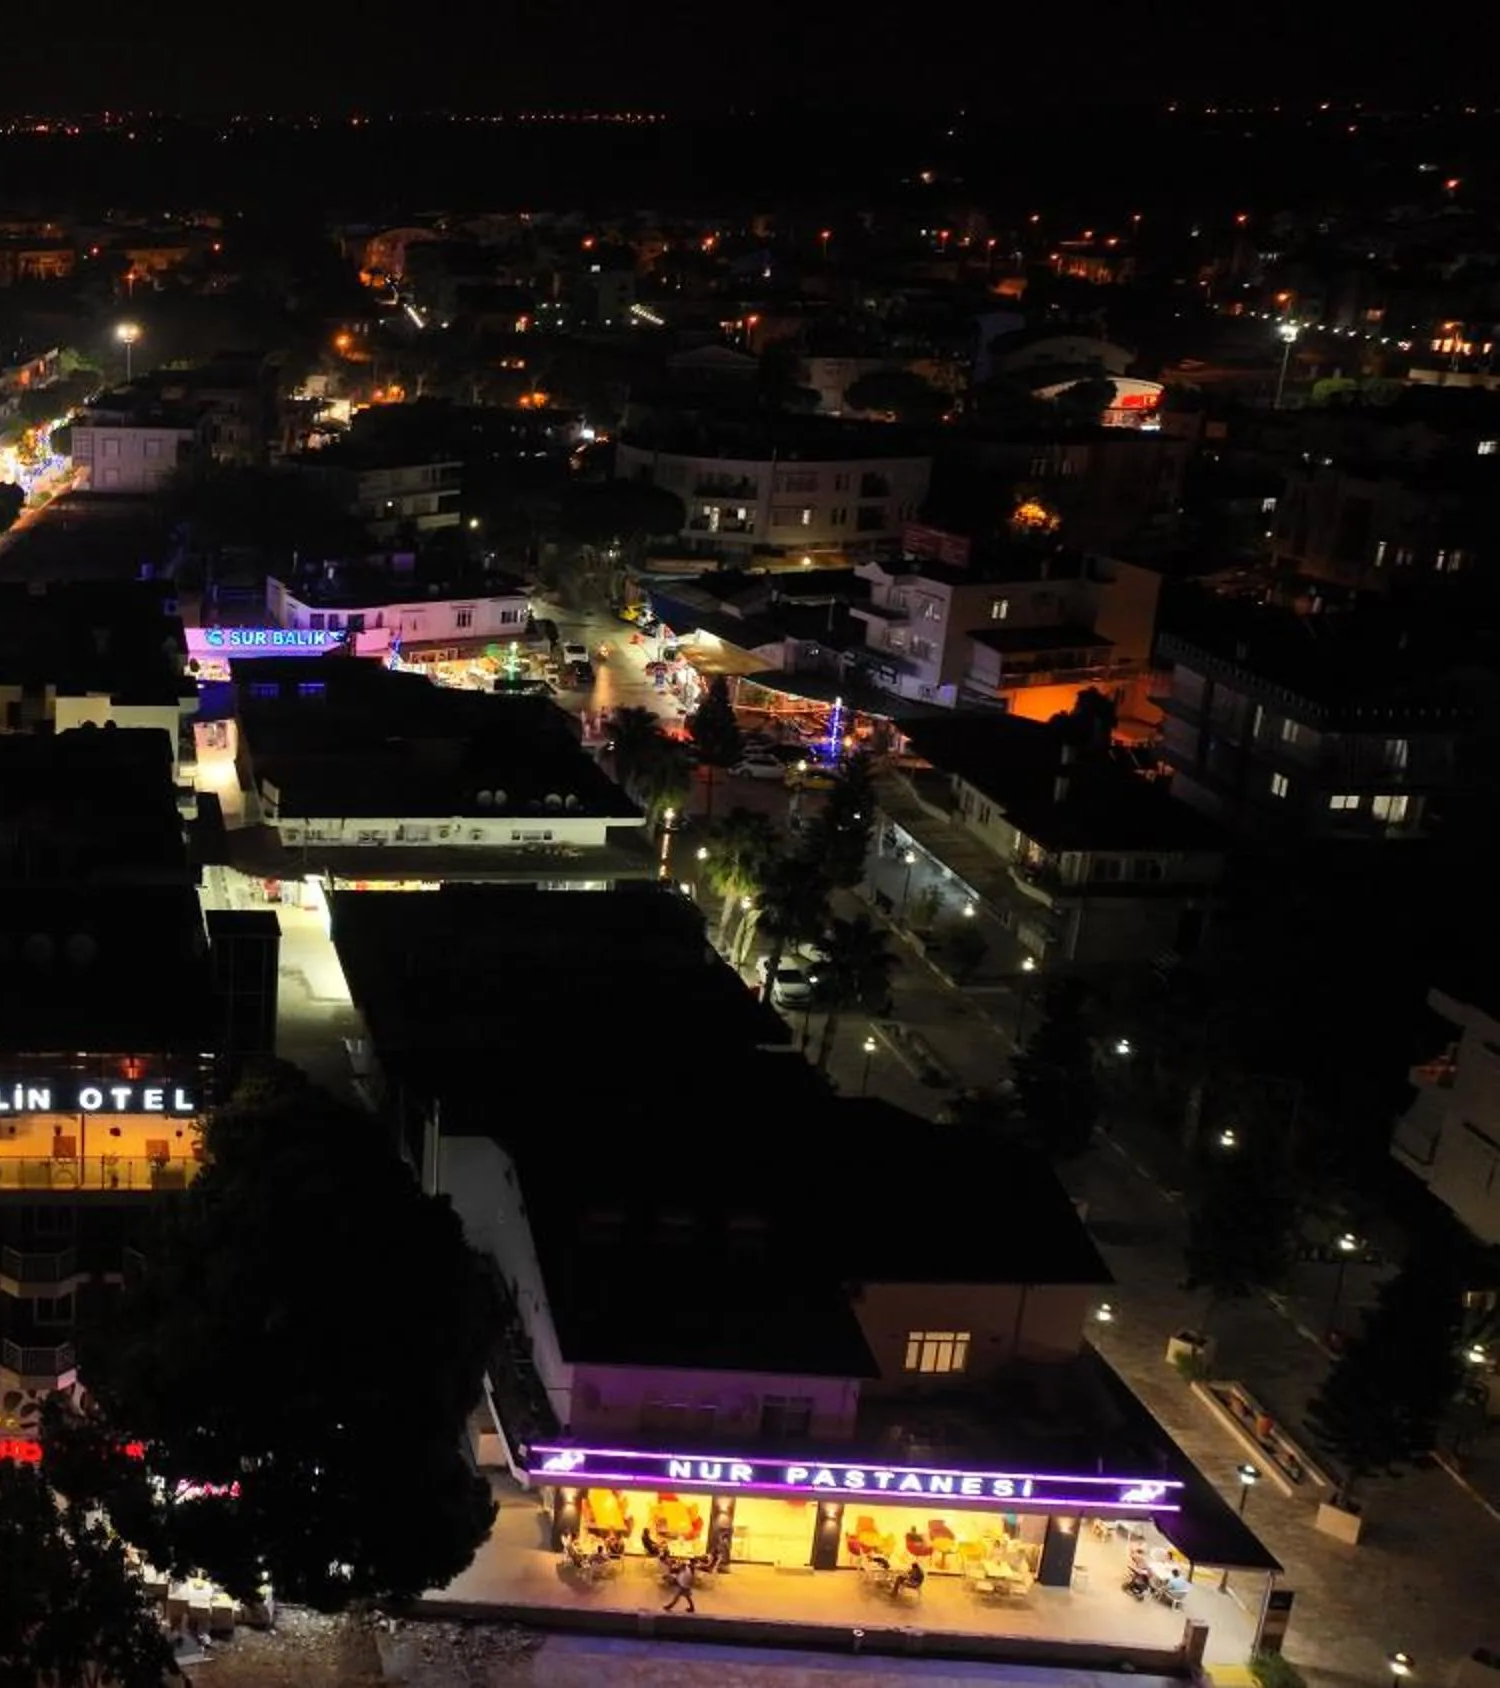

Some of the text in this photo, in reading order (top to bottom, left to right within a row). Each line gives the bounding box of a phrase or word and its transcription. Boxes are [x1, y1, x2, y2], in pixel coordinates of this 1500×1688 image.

[230, 630, 325, 645] SUR BALIK
[79, 1088, 193, 1110] OTEL
[668, 1459, 1033, 1498] NUR PASTANESİ
